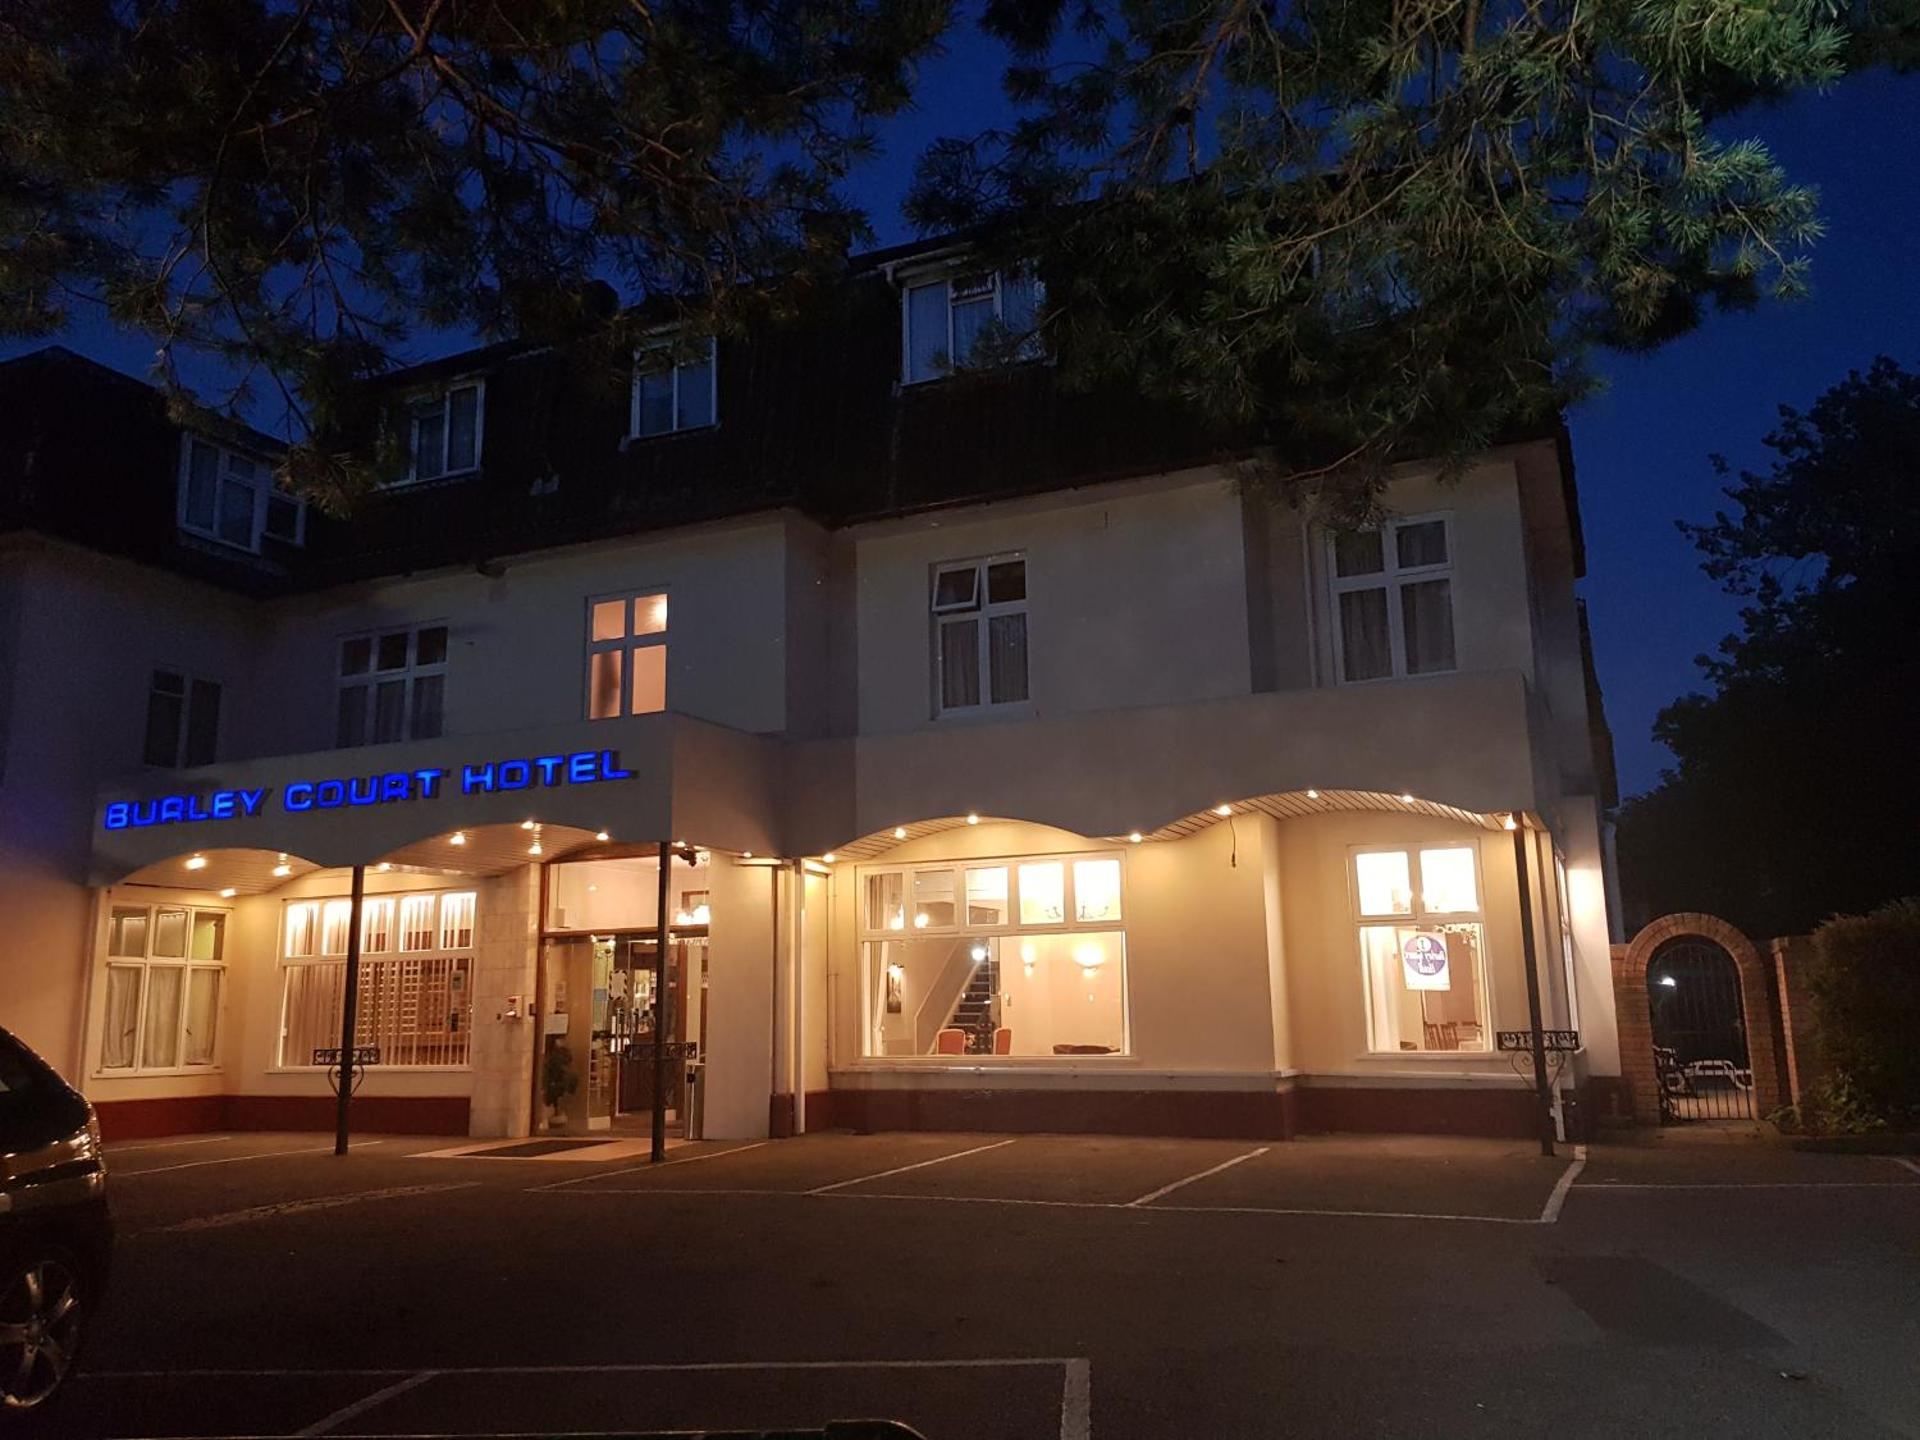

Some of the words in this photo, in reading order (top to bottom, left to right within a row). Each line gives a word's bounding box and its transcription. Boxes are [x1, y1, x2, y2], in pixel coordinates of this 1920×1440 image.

[104, 787, 264, 829] BURLEY
[283, 768, 442, 813] COURT
[461, 751, 633, 793] HOTEL
